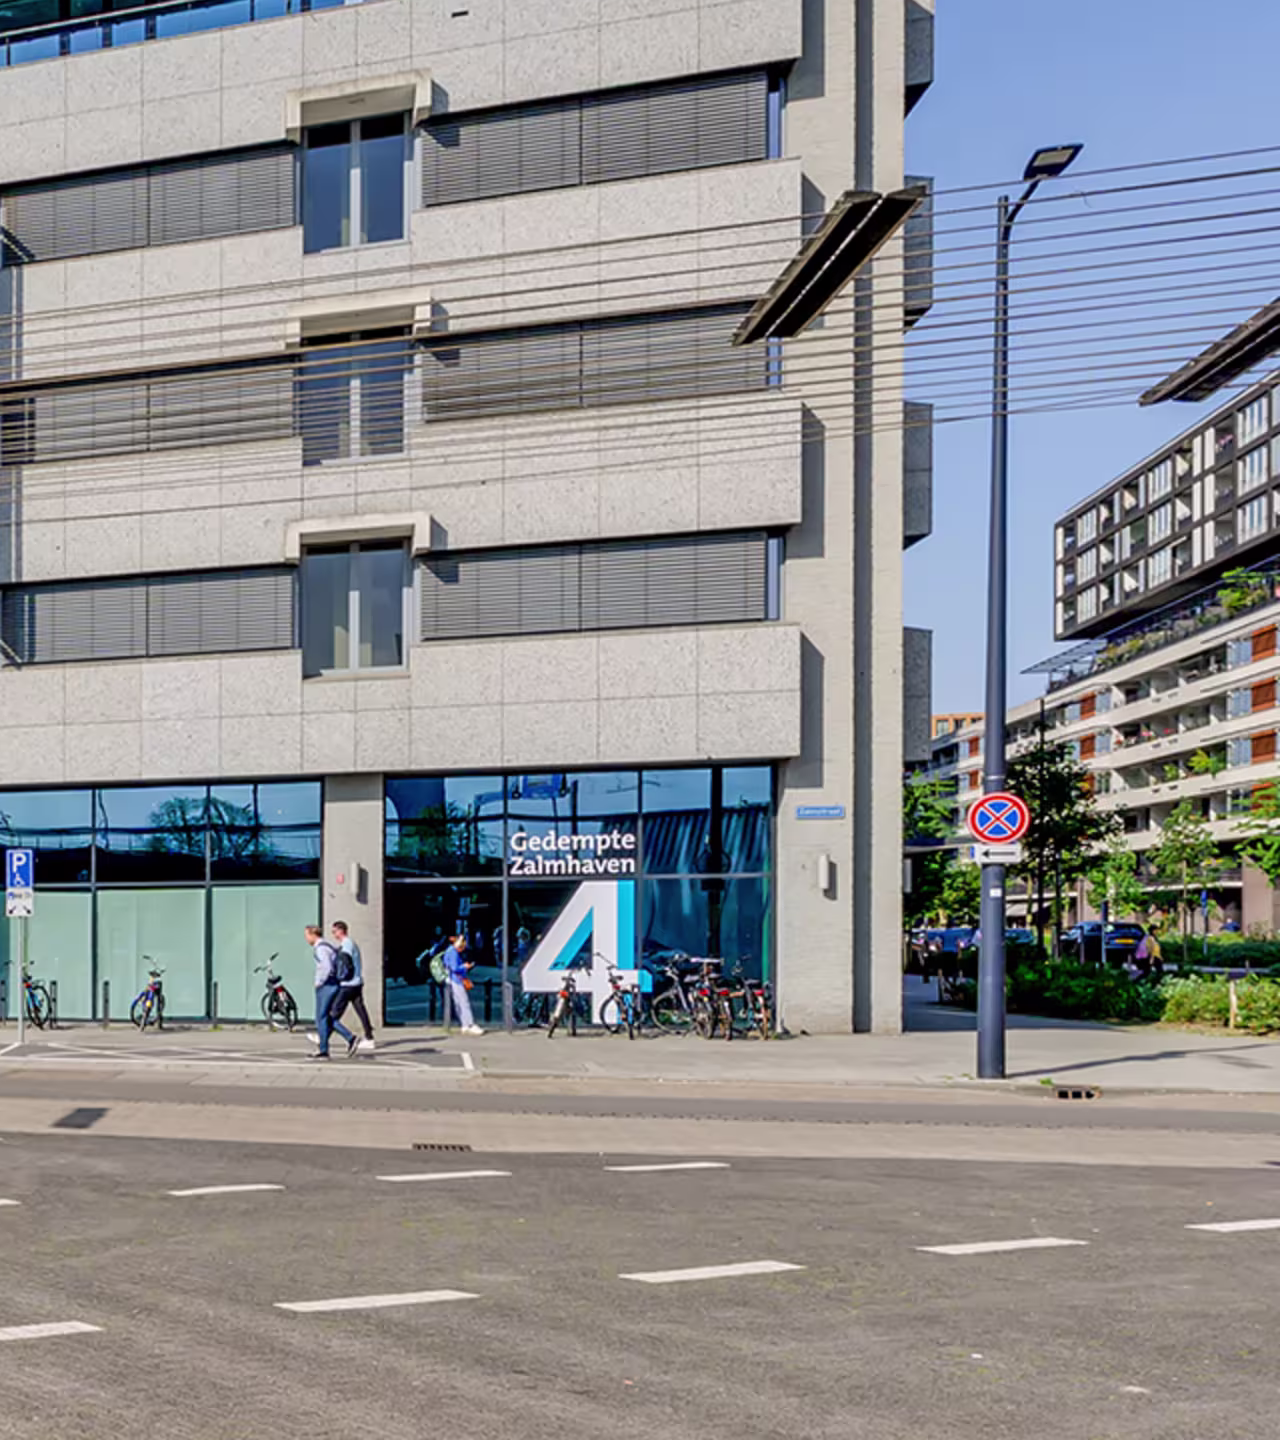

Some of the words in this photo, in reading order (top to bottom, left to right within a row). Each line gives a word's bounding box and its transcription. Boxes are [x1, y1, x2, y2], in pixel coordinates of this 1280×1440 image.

[510, 829, 636, 855] Gedempte
[12, 853, 27, 873] P
[509, 855, 636, 875] Zalmhaven
[521, 879, 653, 1025] 4
